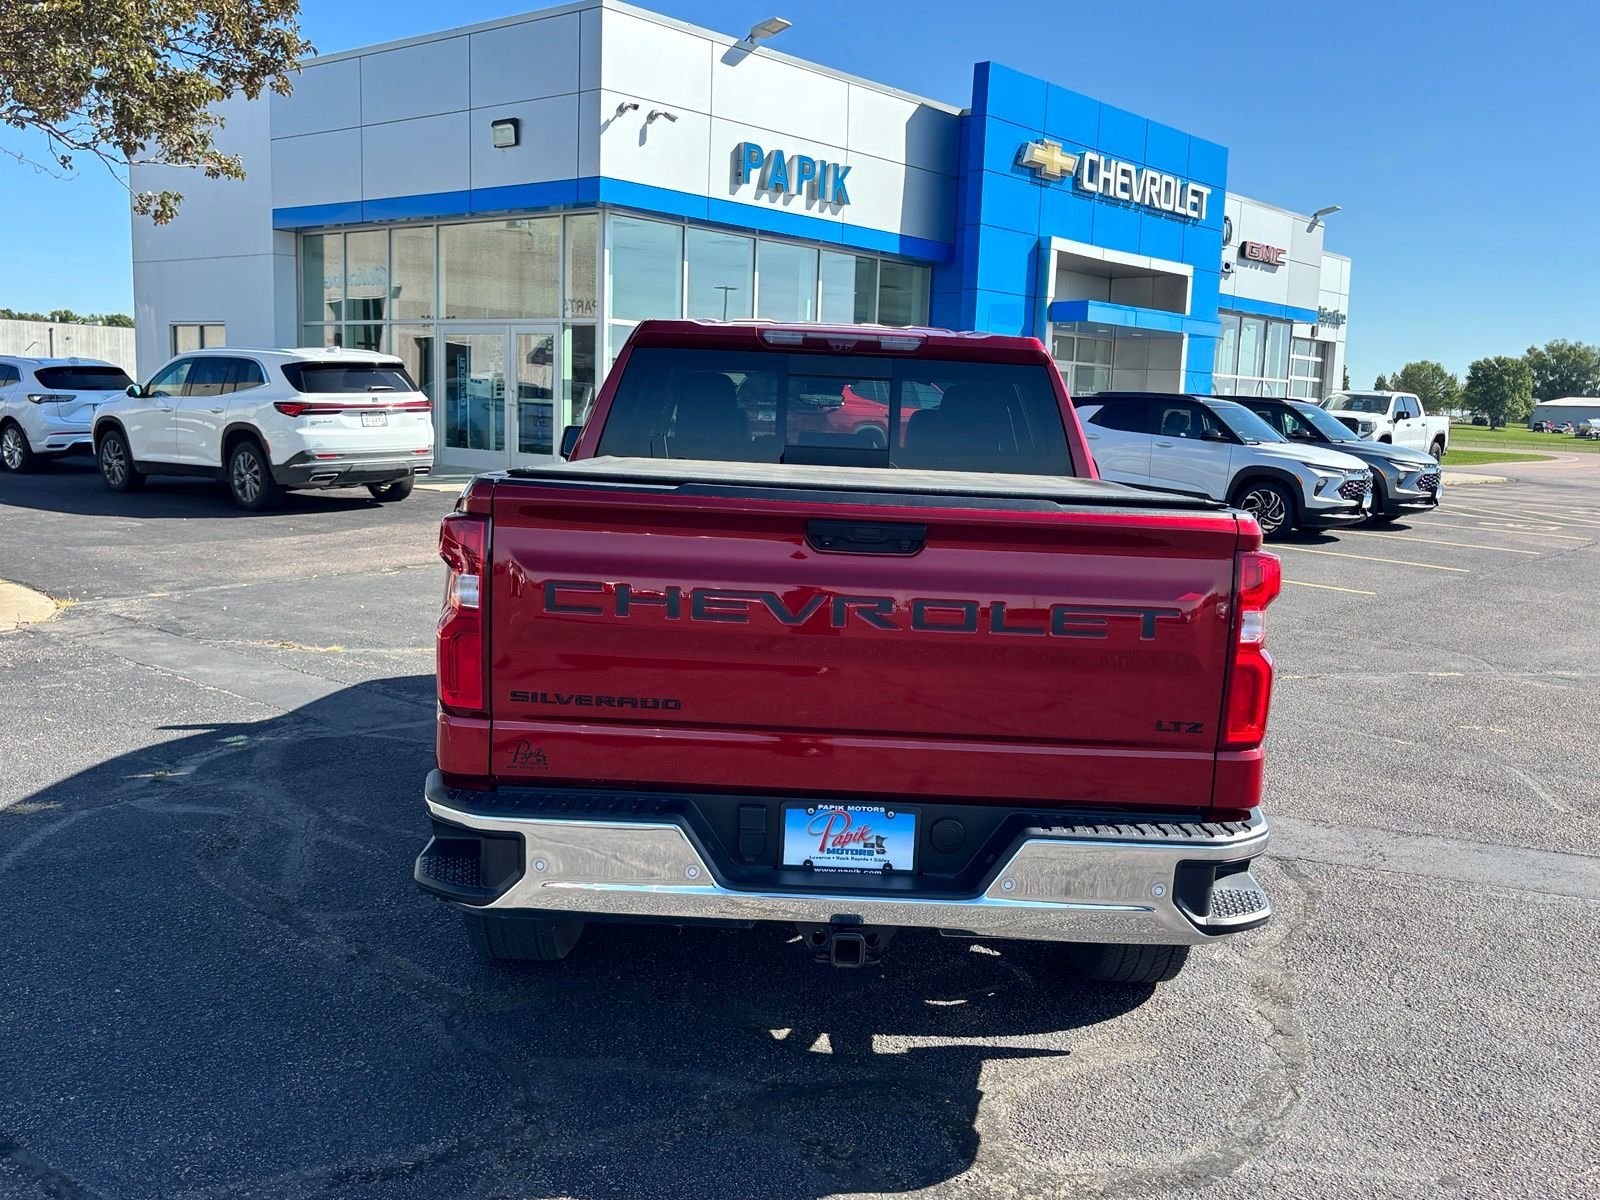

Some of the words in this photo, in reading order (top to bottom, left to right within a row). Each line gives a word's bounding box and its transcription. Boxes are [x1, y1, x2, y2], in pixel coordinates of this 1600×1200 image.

[740, 142, 852, 206] PAPIK
[1079, 151, 1212, 221] CHEVROLET
[1244, 240, 1287, 267] GMC
[543, 580, 1184, 642] CHEVROLET
[510, 690, 682, 711] SILVERADO
[1155, 720, 1204, 734] LTZ
[847, 805, 886, 813] MOTORS
[807, 810, 873, 854] Papik
[826, 847, 875, 857] MOTORS
